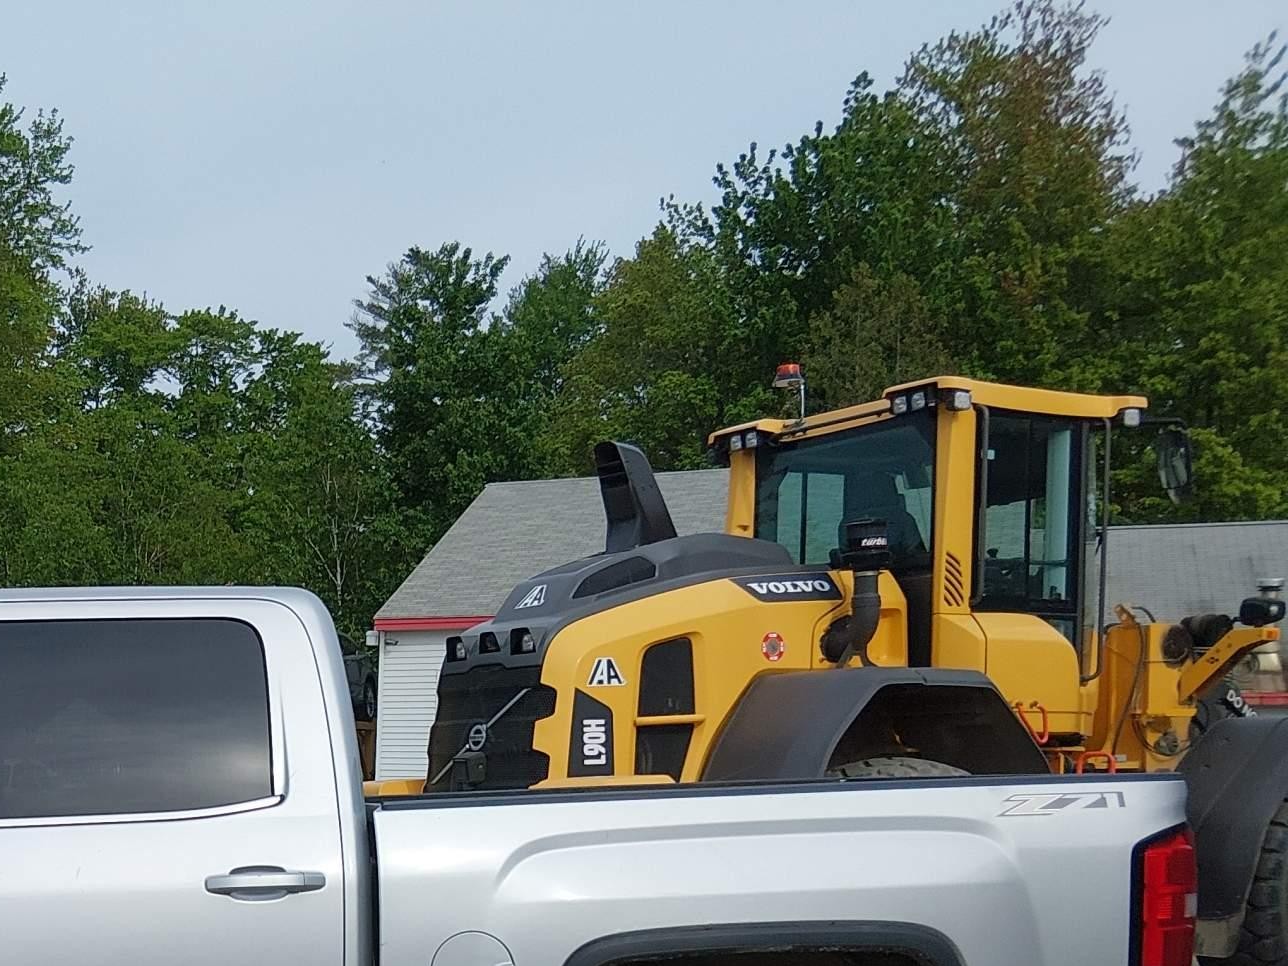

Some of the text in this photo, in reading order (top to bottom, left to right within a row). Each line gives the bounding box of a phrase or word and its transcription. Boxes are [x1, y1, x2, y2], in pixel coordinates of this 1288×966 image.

[747, 579, 832, 594] VOLVO
[583, 719, 607, 766] L90H
[997, 791, 1126, 817] Z71
